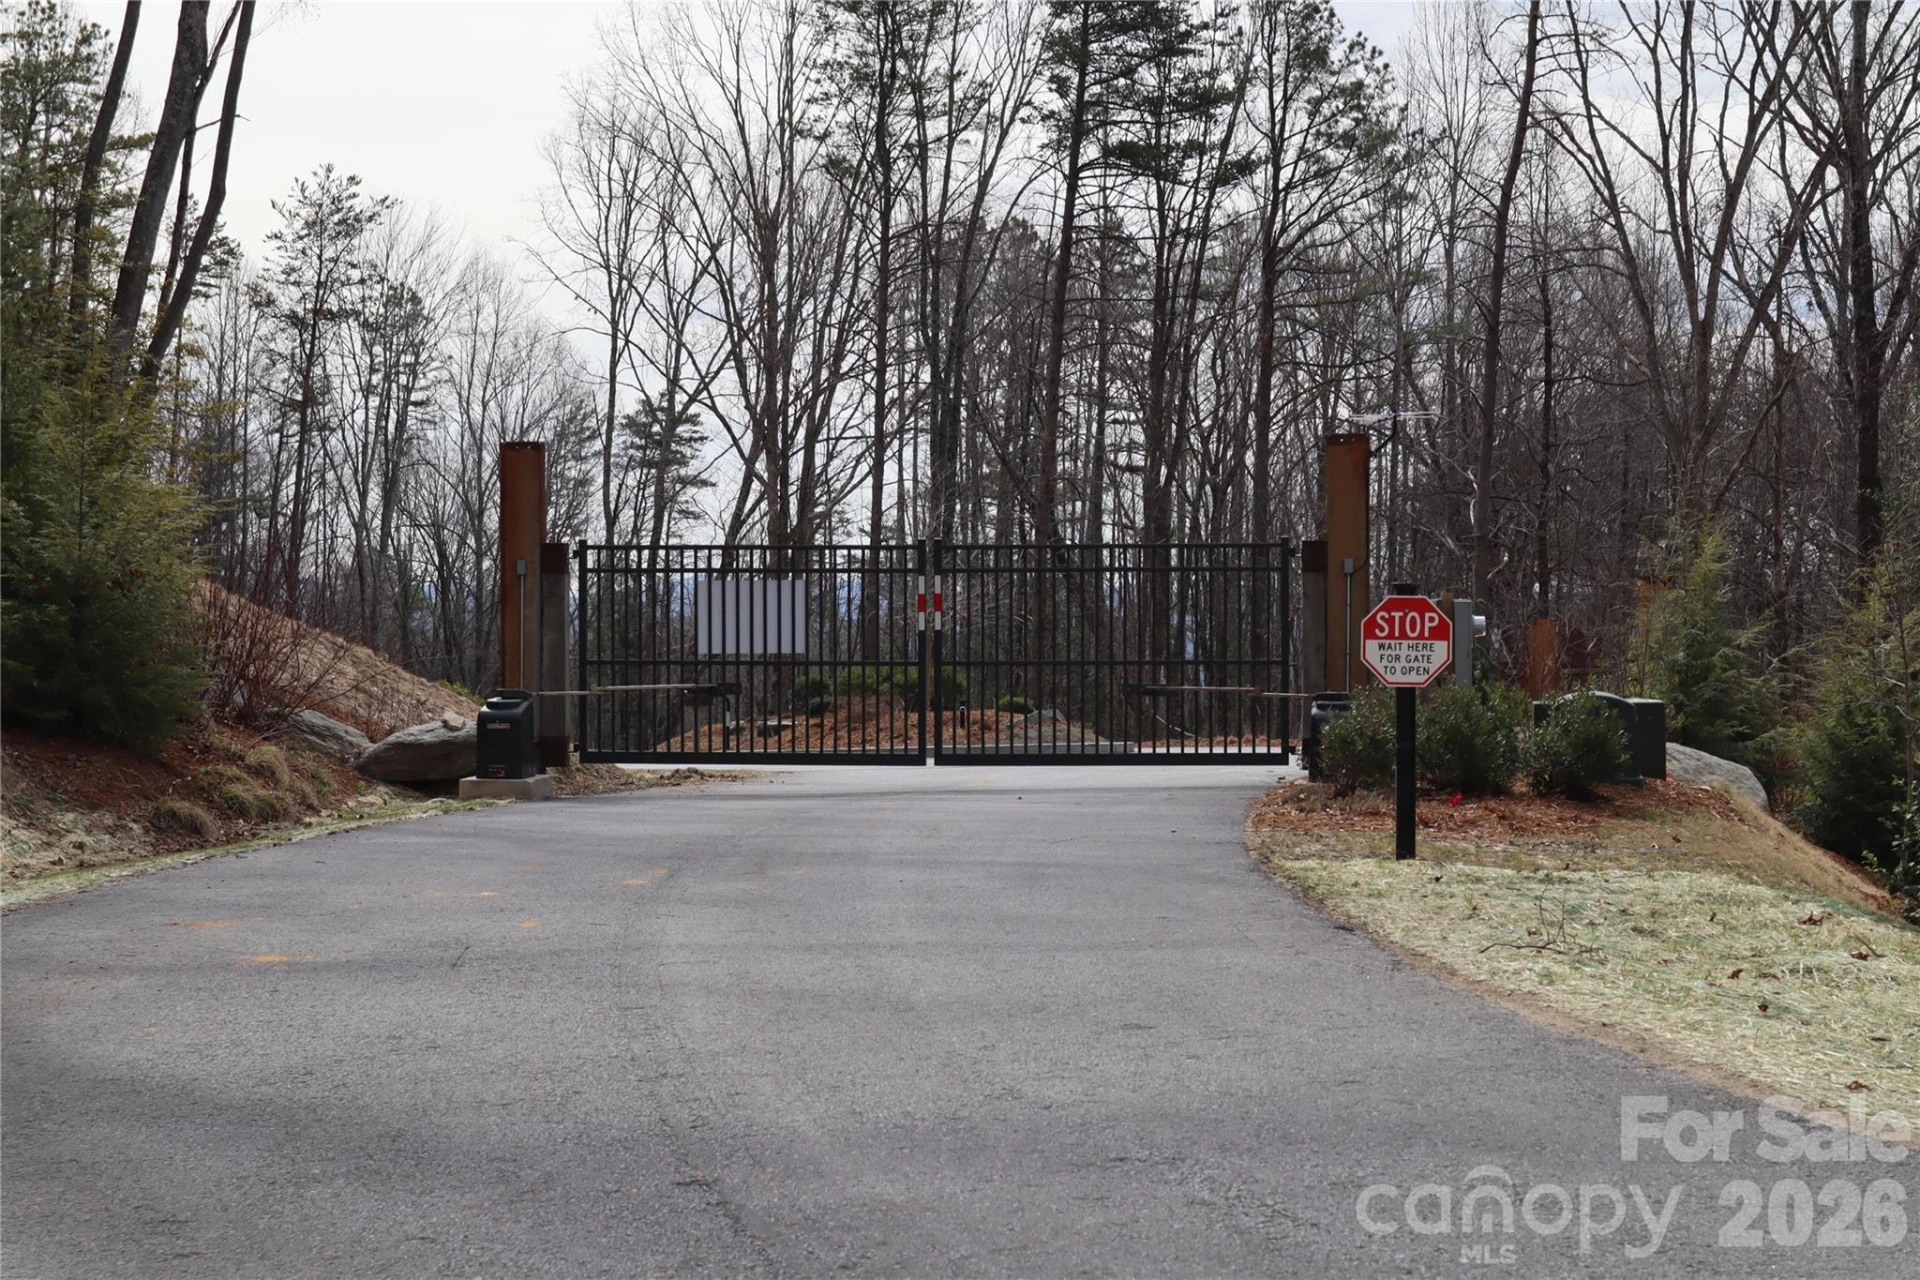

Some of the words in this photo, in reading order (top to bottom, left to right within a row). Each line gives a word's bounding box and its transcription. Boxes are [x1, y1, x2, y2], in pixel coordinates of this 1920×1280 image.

[1374, 611, 1440, 638] STOP
[1378, 642, 1404, 652] WAIT
[1407, 642, 1435, 652] HERE
[1380, 654, 1401, 664] FOR
[1405, 654, 1433, 664] GATE
[1383, 666, 1397, 675] TO
[1401, 666, 1430, 675] OPEN
